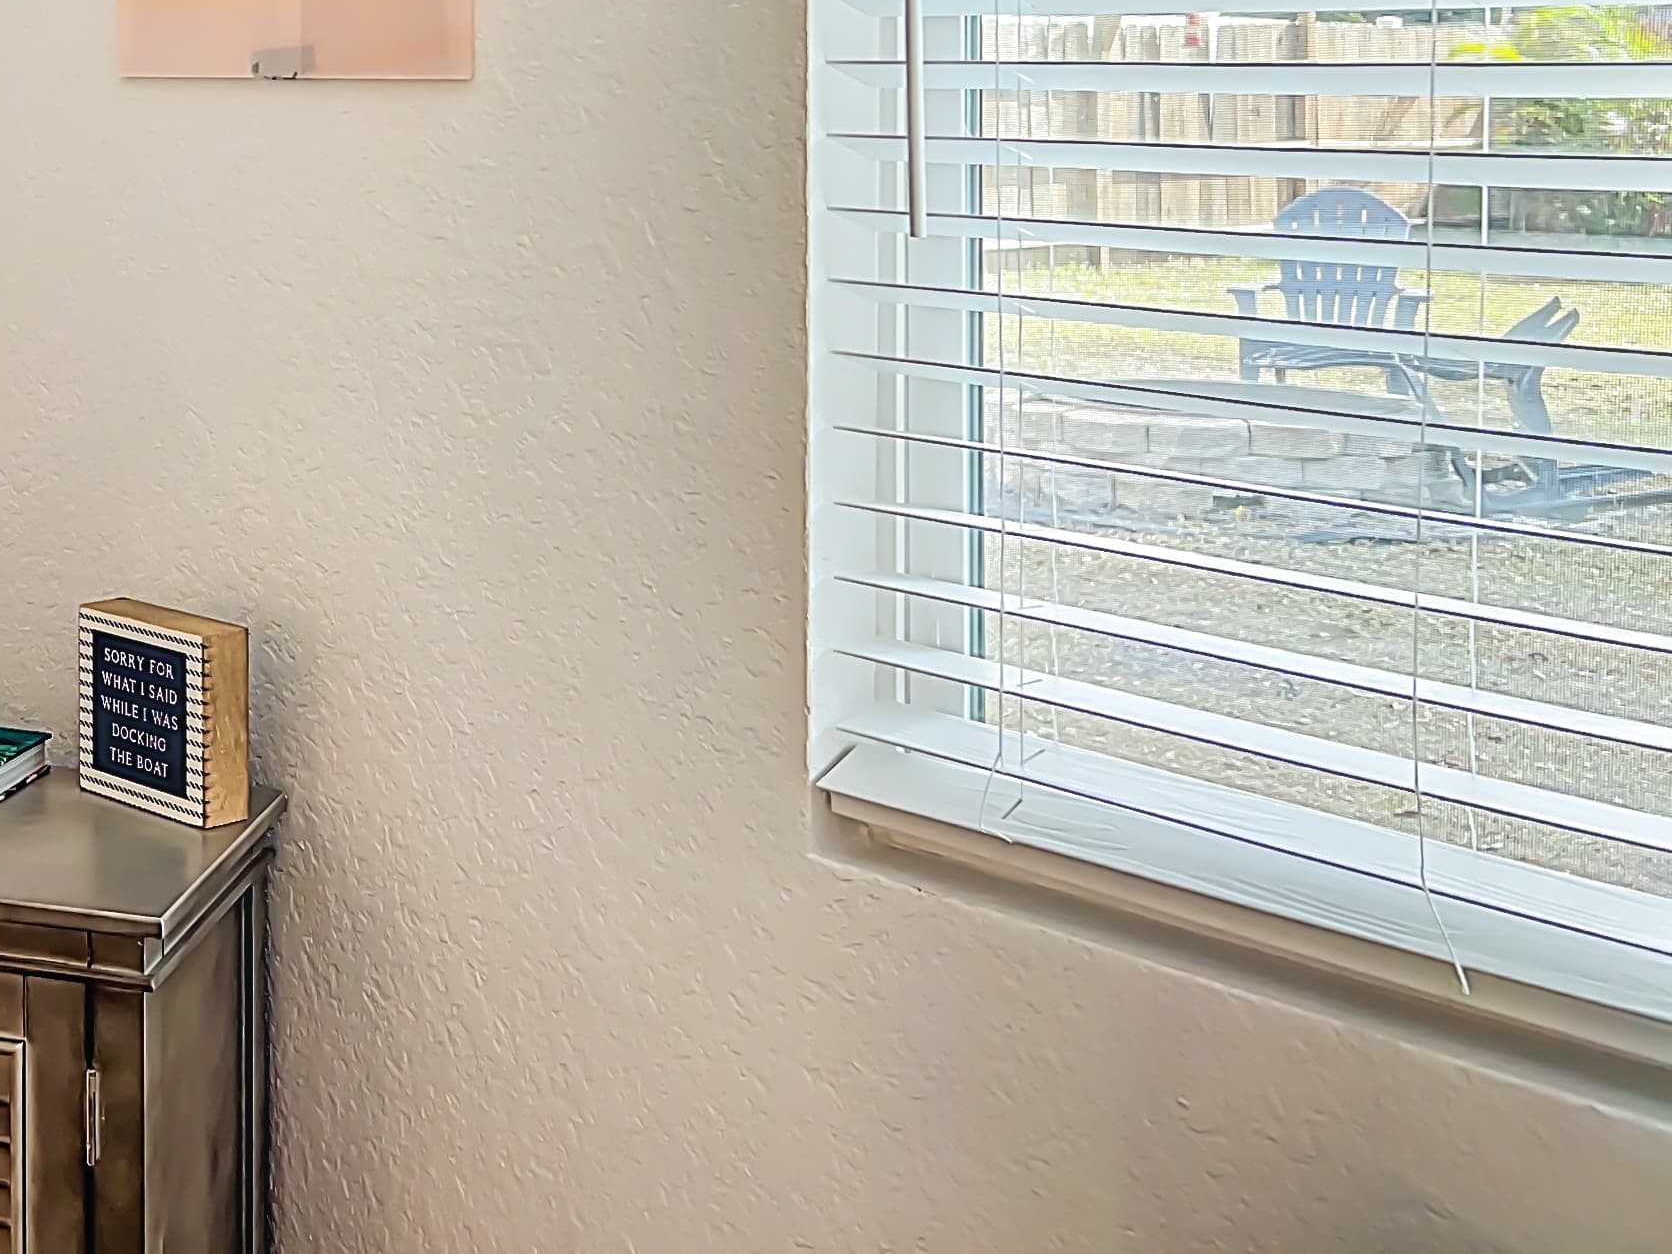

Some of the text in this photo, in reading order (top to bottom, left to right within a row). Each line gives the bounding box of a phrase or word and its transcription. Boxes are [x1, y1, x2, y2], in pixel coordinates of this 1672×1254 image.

[104, 647, 174, 679] SORRY FOR
[102, 670, 178, 705] WHAT I SAID
[100, 695, 178, 731] WHILE I WAS
[112, 723, 166, 752] DOCKING
[109, 747, 168, 778] THE BOAT
